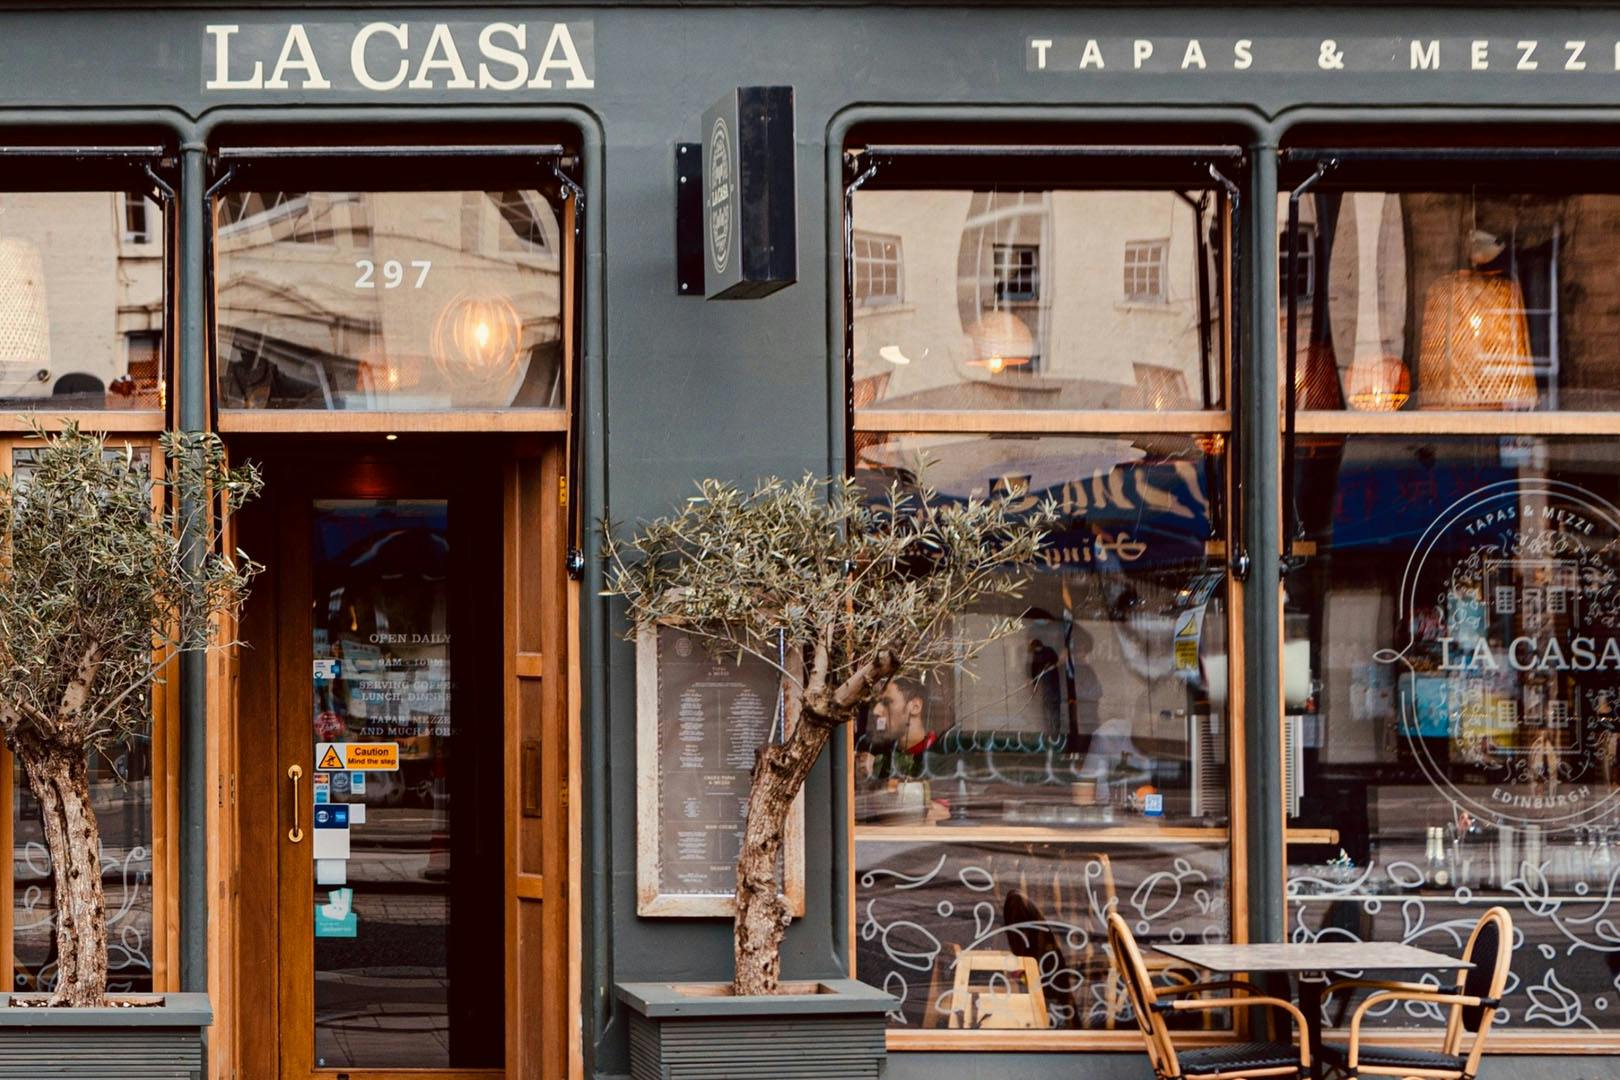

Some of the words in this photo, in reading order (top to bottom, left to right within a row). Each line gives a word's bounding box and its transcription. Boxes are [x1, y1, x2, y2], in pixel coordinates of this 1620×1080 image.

[206, 24, 331, 90] LA
[350, 22, 595, 91] CASA
[1031, 39, 1253, 69] TAPAS
[1317, 39, 1345, 70] &
[355, 260, 432, 288] 297
[1465, 506, 1516, 536] TAPAS
[1523, 505, 1534, 517] &
[1542, 506, 1595, 536] MEZZE
[369, 633, 407, 644] OPEN
[412, 633, 452, 643] DAILY
[1437, 637, 1499, 670] LA
[1508, 635, 1620, 671] CASA
[360, 681, 409, 690] SERVING
[360, 727, 384, 736] AND
[388, 727, 422, 736] MUCH
[354, 747, 389, 757] Caution
[380, 758, 396, 767] step
[1491, 785, 1591, 809] EDINBURGH
